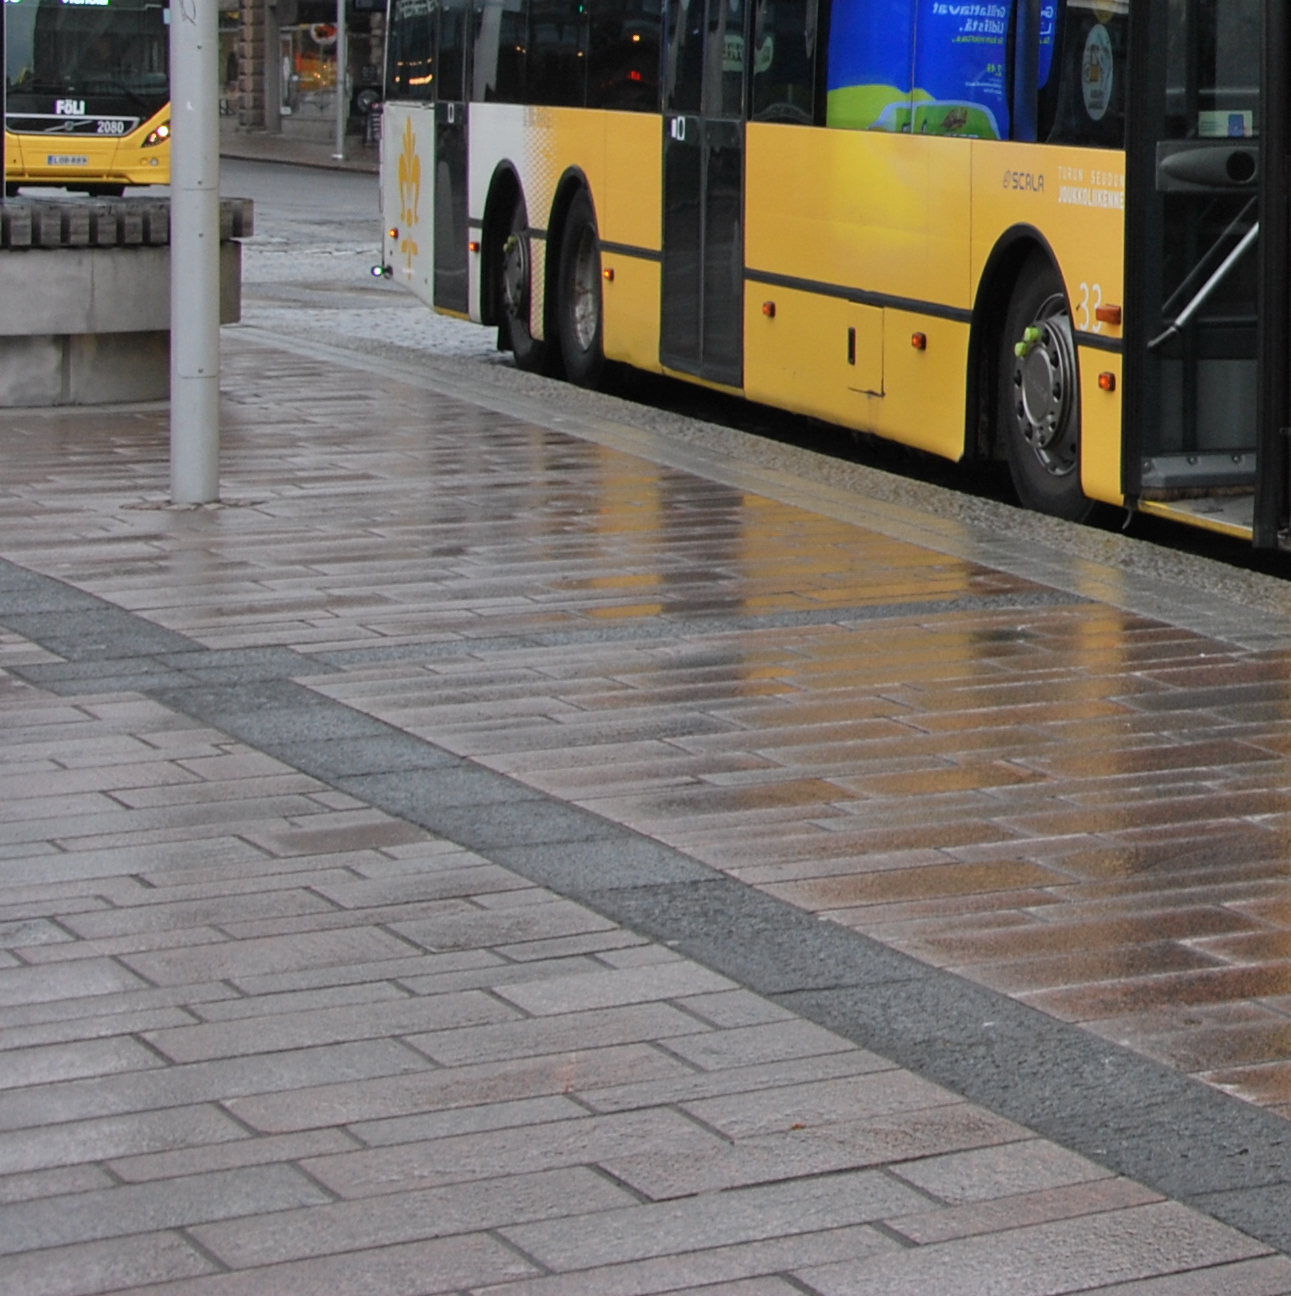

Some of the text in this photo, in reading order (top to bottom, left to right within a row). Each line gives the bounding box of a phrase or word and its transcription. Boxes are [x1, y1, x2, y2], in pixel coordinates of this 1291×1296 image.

[97, 121, 125, 135] 2080
[1011, 171, 1045, 192] SCALA
[1058, 166, 1083, 181] TURUN
[1079, 282, 1102, 333] 33
